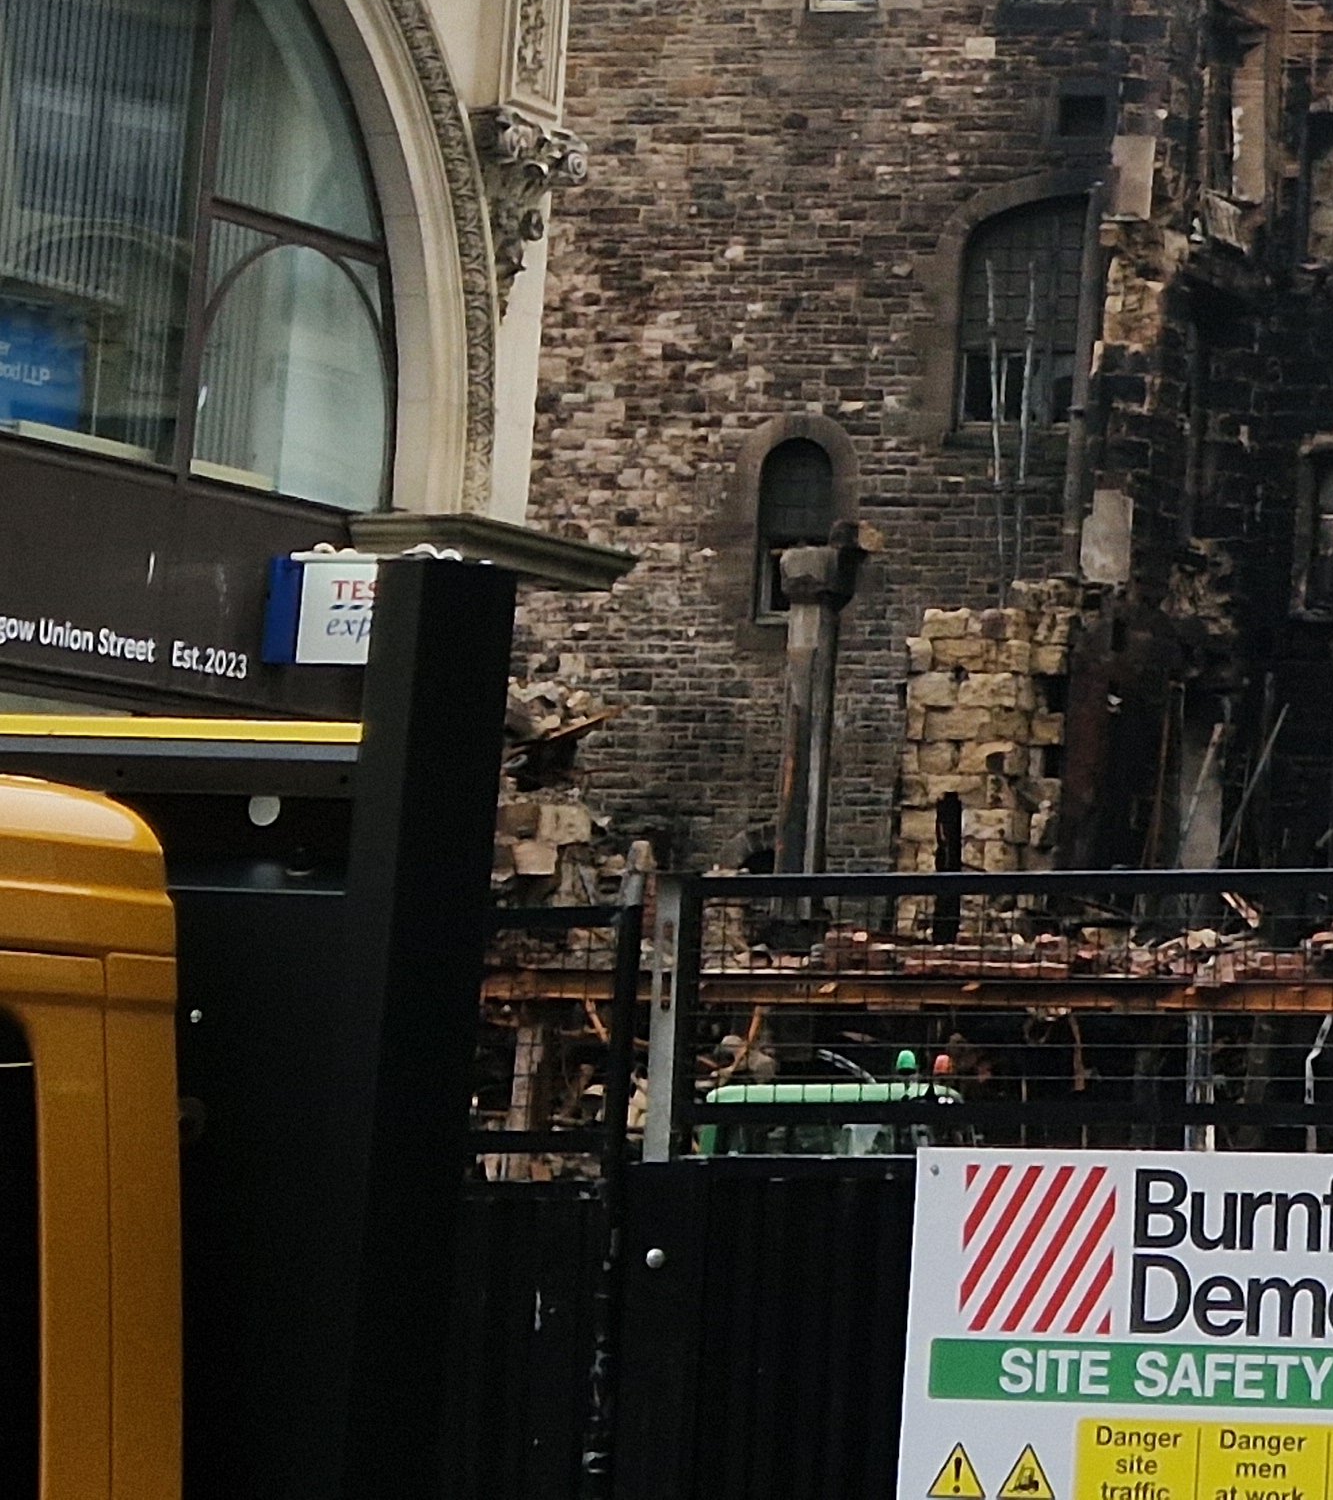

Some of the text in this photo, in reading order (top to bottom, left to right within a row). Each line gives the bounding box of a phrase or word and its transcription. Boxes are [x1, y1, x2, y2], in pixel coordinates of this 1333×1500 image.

[39, 617, 94, 653] Union
[97, 627, 156, 663] Street
[172, 640, 248, 679] Est.2023
[1000, 1348, 1110, 1396] SITE
[1095, 1424, 1182, 1450] Danger
[1219, 1428, 1307, 1454] Danger
[1115, 1453, 1158, 1475] site
[1235, 1461, 1287, 1479] men
[1101, 1481, 1170, 1500] traffic
